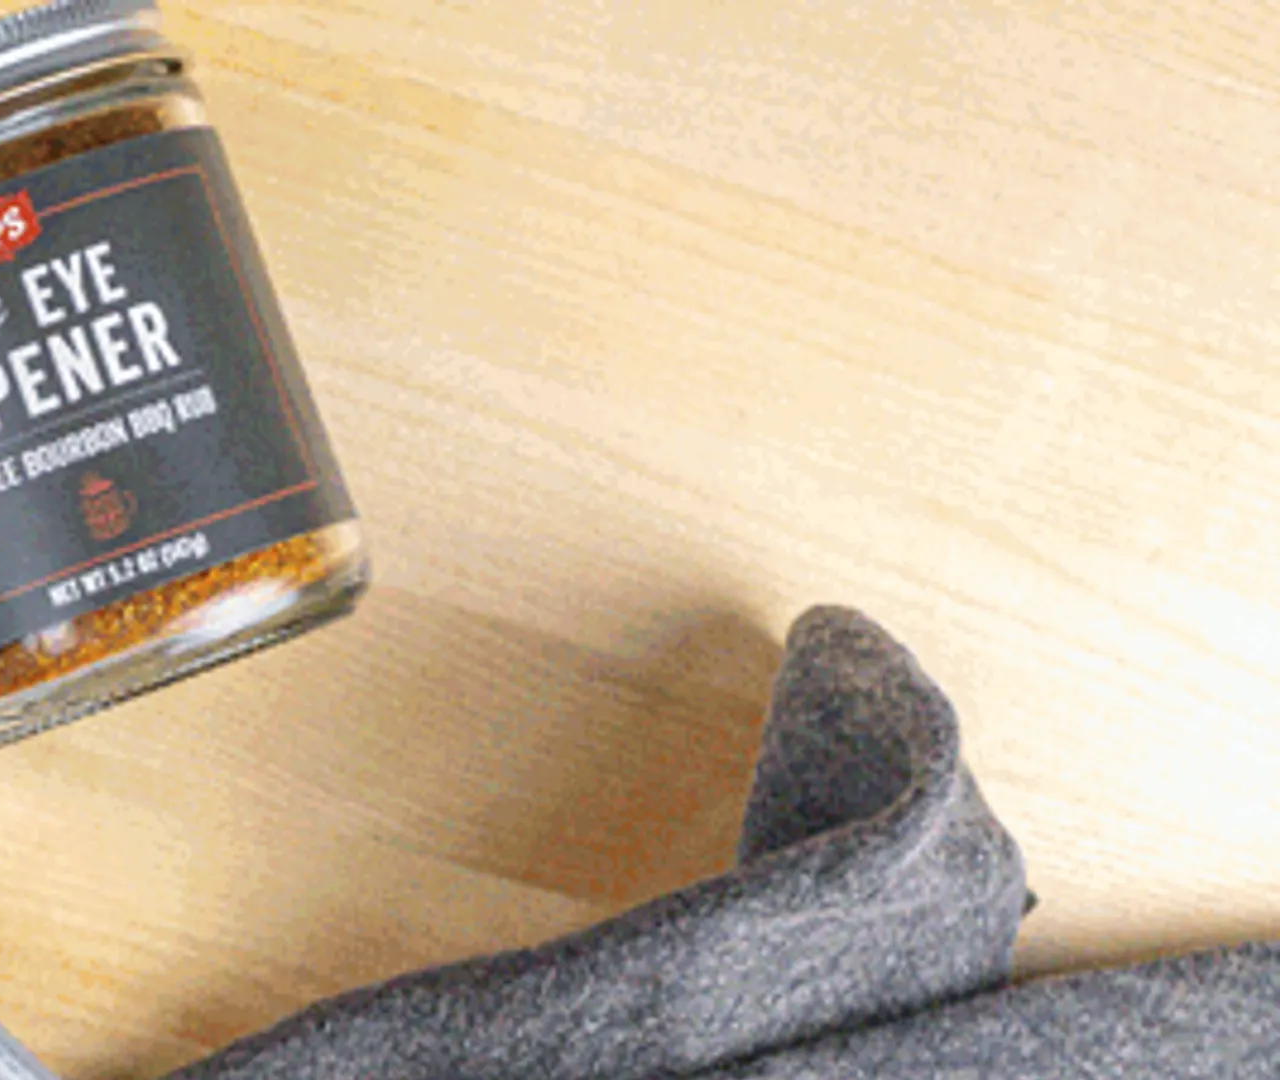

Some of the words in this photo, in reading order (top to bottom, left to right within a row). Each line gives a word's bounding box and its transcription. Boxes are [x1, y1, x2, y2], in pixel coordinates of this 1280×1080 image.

[21, 240, 127, 328] EYE
[21, 417, 129, 480] BOURBON
[127, 398, 177, 439] BBQ
[175, 385, 217, 422] RUB
[47, 577, 82, 608] NET
